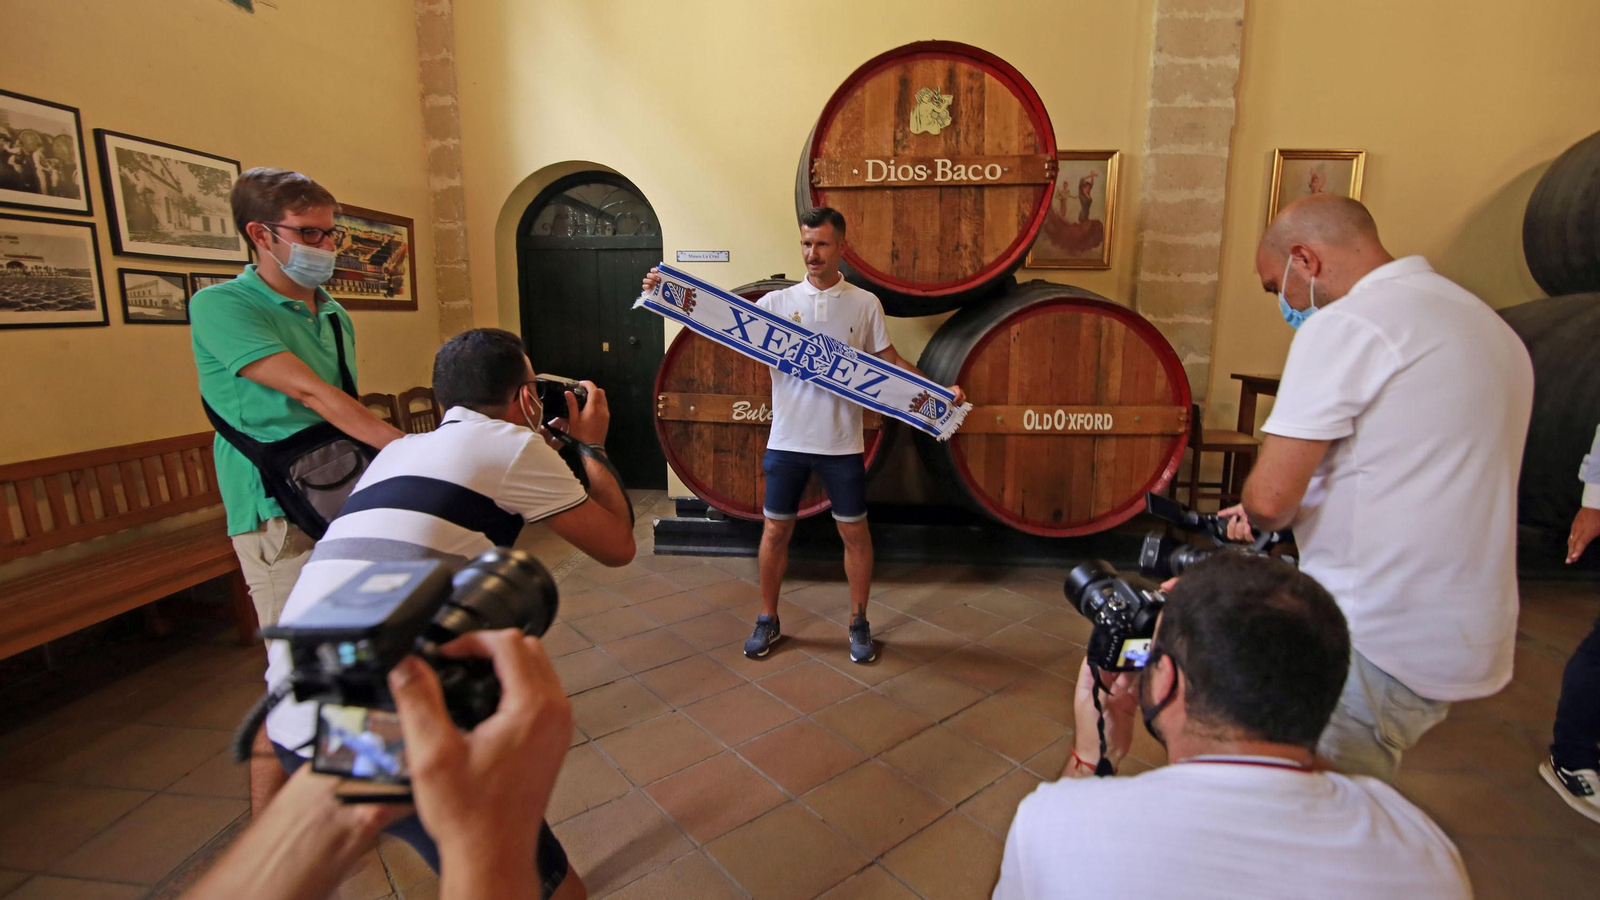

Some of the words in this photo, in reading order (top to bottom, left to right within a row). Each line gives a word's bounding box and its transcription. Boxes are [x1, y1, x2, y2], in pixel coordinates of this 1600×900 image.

[865, 159, 927, 182] Dios
[934, 158, 1002, 182] Baco
[722, 306, 889, 399] XEREZ
[939, 409, 954, 426] XEREZ
[1023, 408, 1052, 431] OLD
